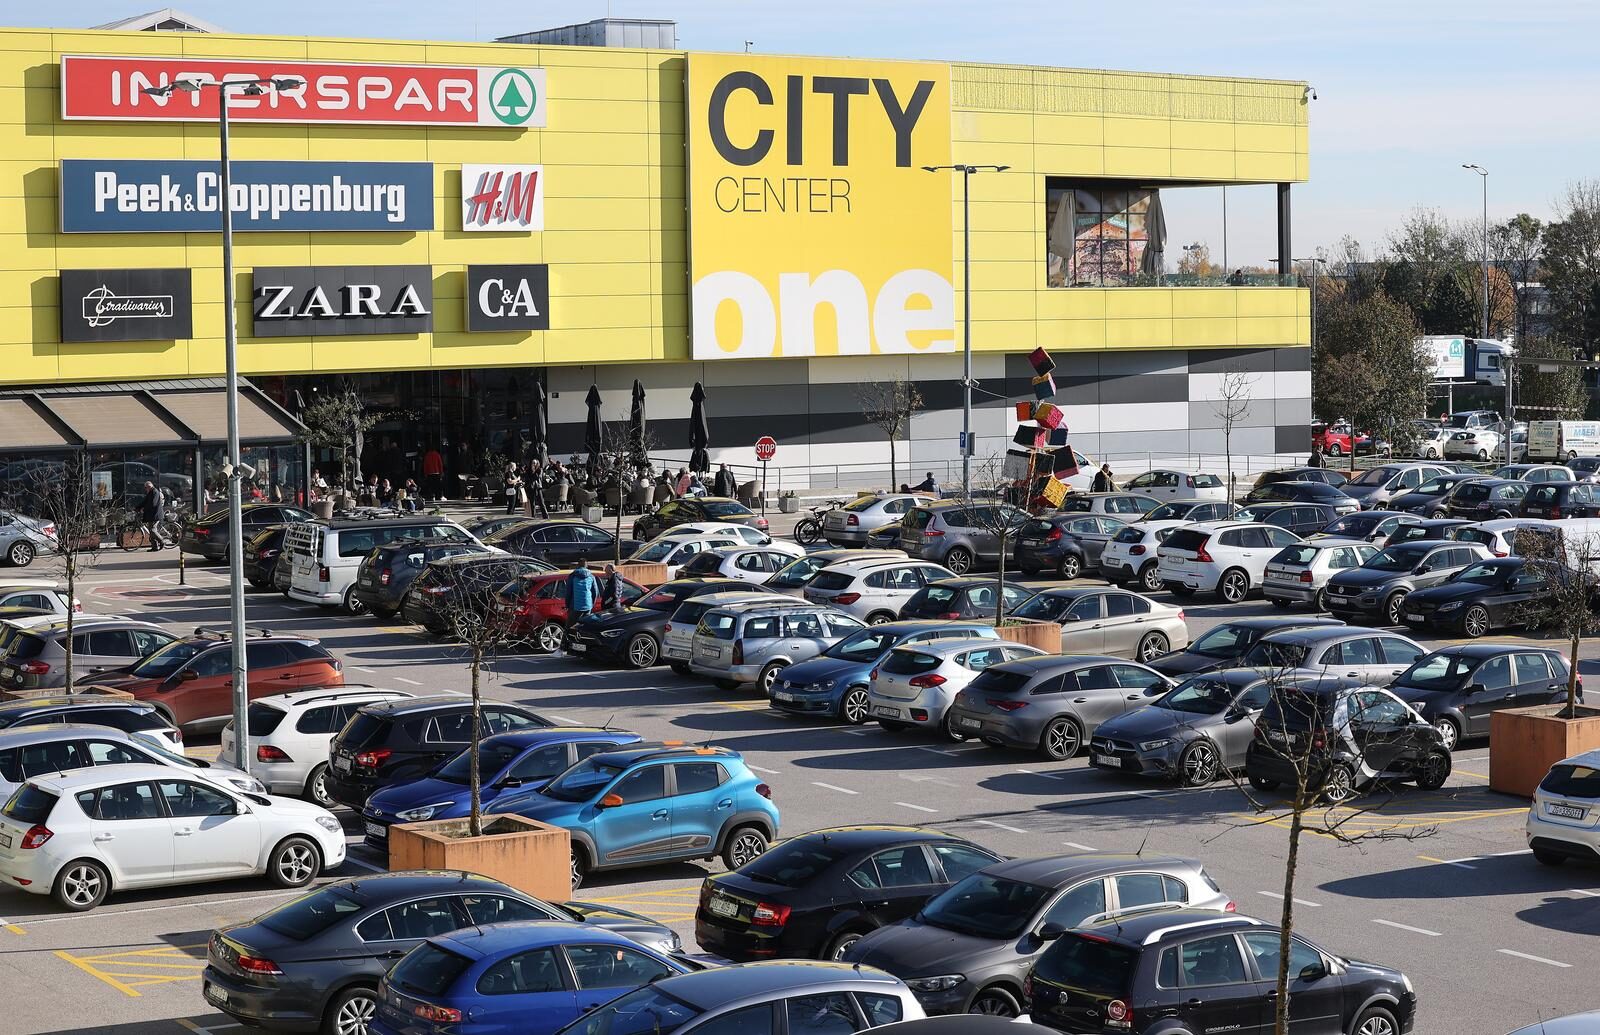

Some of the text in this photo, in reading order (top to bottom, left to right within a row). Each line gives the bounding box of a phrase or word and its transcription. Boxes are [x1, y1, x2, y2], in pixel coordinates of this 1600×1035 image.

[111, 70, 473, 112] INTERSPAR
[708, 71, 936, 168] CITY
[466, 171, 538, 226] H&M
[715, 176, 851, 213] CENTER
[258, 284, 431, 318] ZARA
[478, 278, 539, 317] C&A
[693, 268, 955, 360] one
[757, 443, 774, 454] STOP
